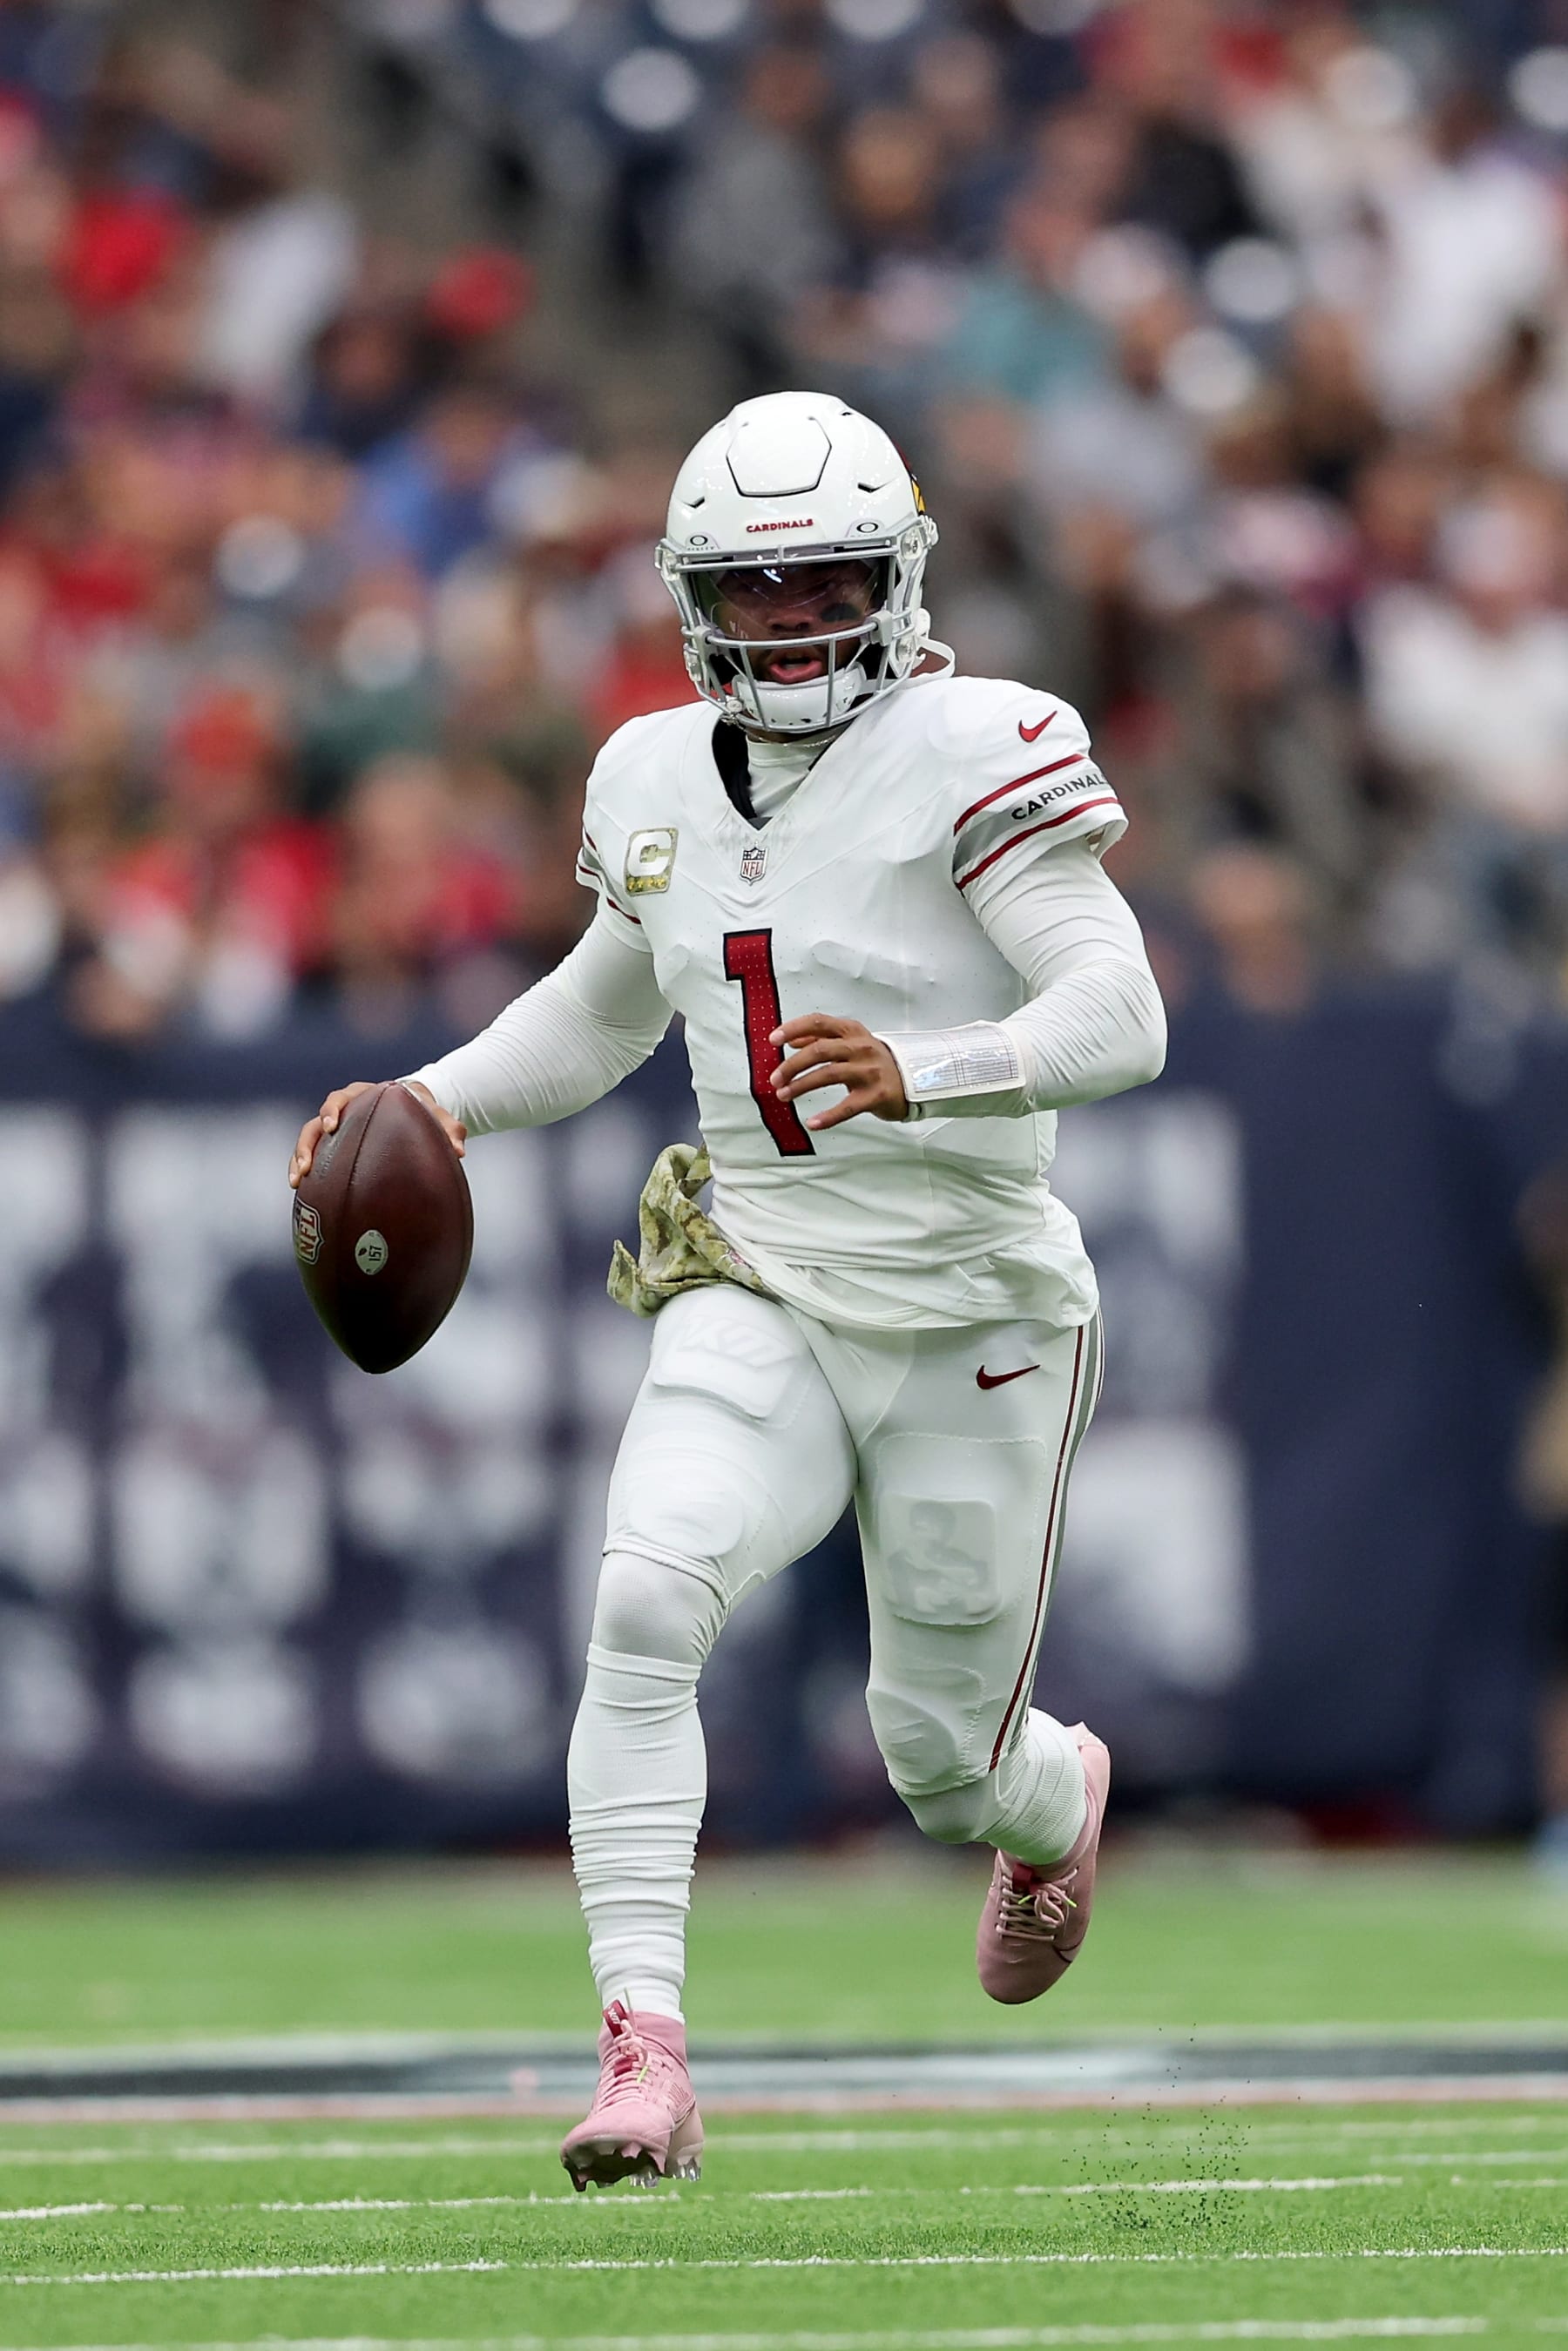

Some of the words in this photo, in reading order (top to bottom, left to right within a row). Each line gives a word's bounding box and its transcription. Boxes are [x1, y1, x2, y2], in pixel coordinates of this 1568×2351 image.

[746, 518, 814, 533] CARDINALS
[627, 831, 672, 877] C
[742, 861, 762, 876] NFL
[722, 927, 817, 1158] 1
[300, 1213, 316, 1258] NFL
[368, 1245, 382, 1261] 157
